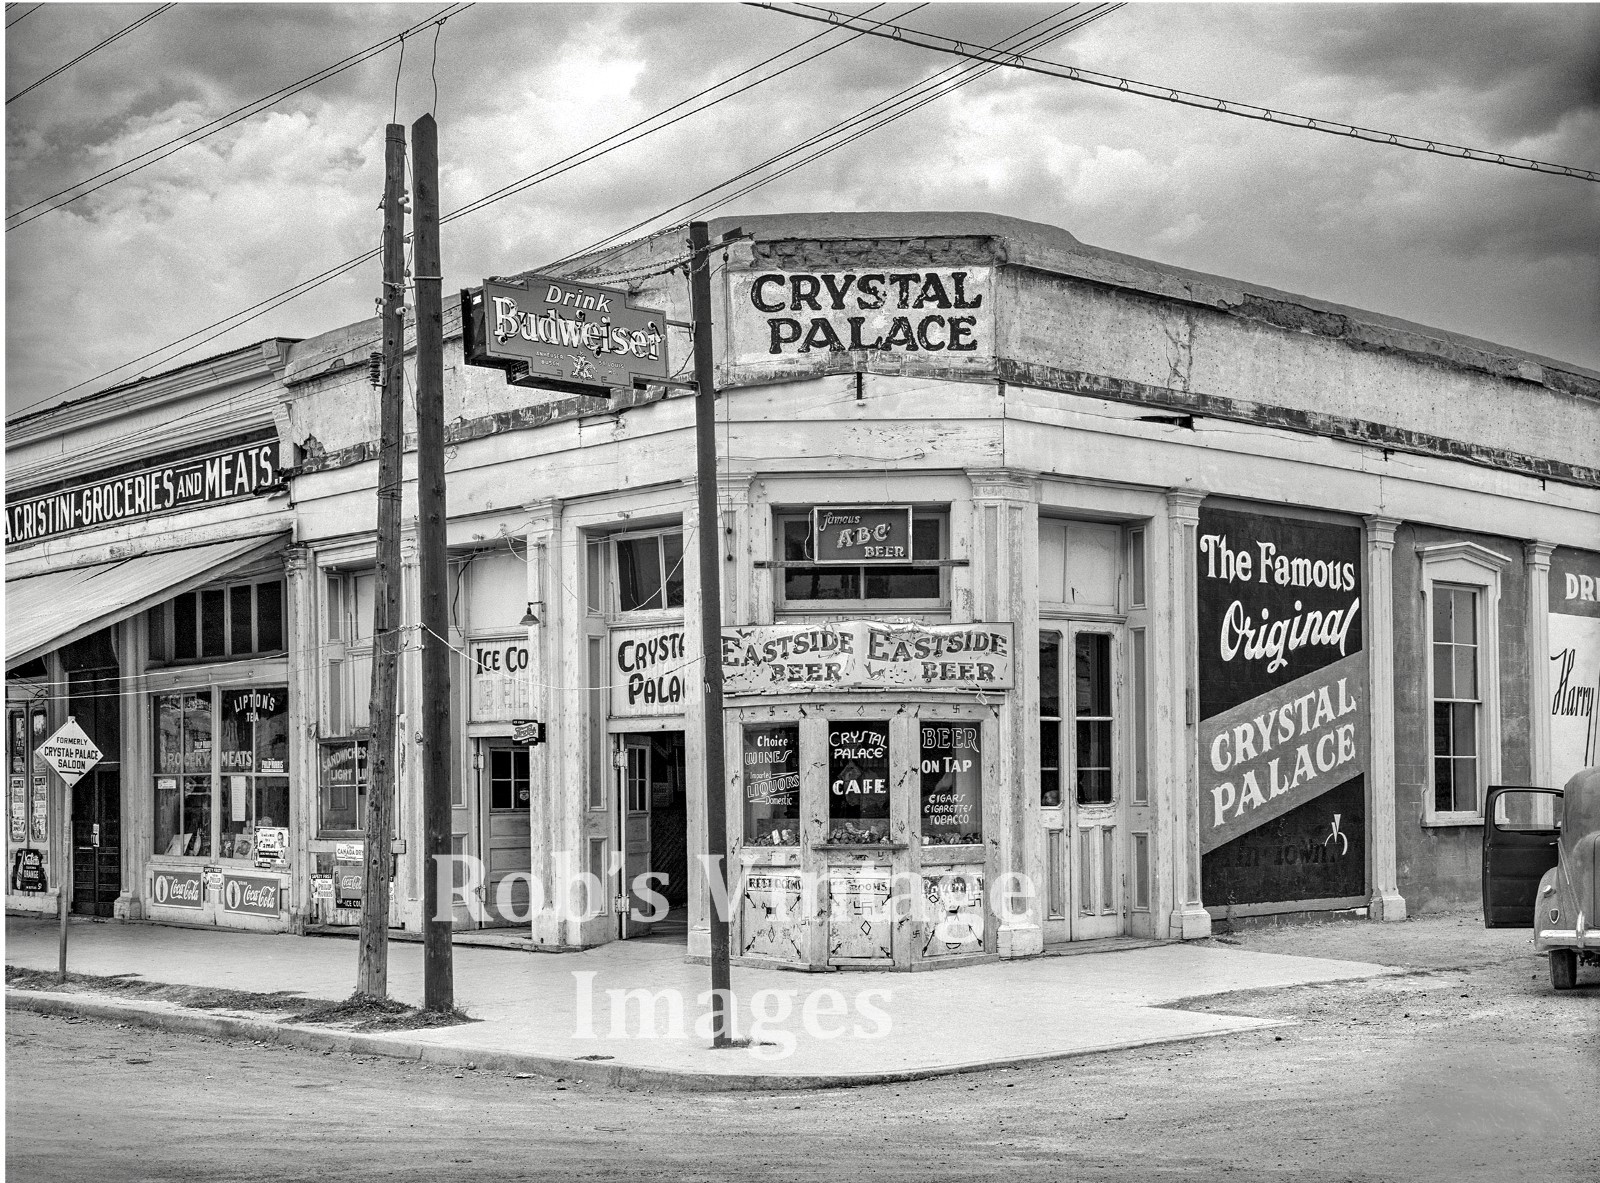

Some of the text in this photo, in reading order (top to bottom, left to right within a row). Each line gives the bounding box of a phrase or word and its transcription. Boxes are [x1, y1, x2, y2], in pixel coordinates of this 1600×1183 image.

[544, 285, 613, 313] Drink
[751, 272, 982, 312] CRYSTAL
[492, 296, 662, 360] Budweiser
[767, 315, 978, 354] PALACE
[176, 472, 202, 499] AND
[819, 512, 860, 531] famous
[864, 546, 905, 557] BEER
[1199, 534, 1356, 592] The Famous
[1220, 597, 1360, 674] Original
[721, 630, 854, 667] EASTSIDE
[867, 629, 1008, 664] EASTSIDE
[770, 662, 842, 683] BEER
[921, 661, 995, 683] BEER
[233, 693, 276, 712] LIPTON'S
[1551, 648, 1595, 768] Harry
[246, 711, 260, 723] TEA
[1210, 677, 1357, 773] CRYSTAL
[56, 736, 88, 746] FORMERLY
[757, 735, 789, 747] Choice
[829, 730, 888, 749] CRYSTAL
[922, 727, 980, 753] BEER
[74, 749, 99, 761] PALACE
[221, 750, 253, 767] MEATS
[322, 746, 367, 773] SANDWICHES
[744, 749, 793, 766] WINES
[833, 747, 884, 759] PALACE
[57, 758, 86, 770] SALOON
[921, 756, 972, 774] ON TAP
[331, 769, 353, 781] LIGHT
[749, 771, 772, 780] Imported
[1210, 722, 1356, 828] PALACE
[746, 774, 800, 799] LIQUORS
[832, 778, 886, 796] CAFE
[765, 794, 793, 806] Domestic
[928, 794, 966, 804] CIGARS
[923, 804, 973, 814] CIGARETTES
[929, 814, 970, 826] TOBACCO
[337, 848, 356, 856] CANADA
[170, 878, 200, 901] Coca-Cola
[243, 884, 276, 909] Coca-Cola
